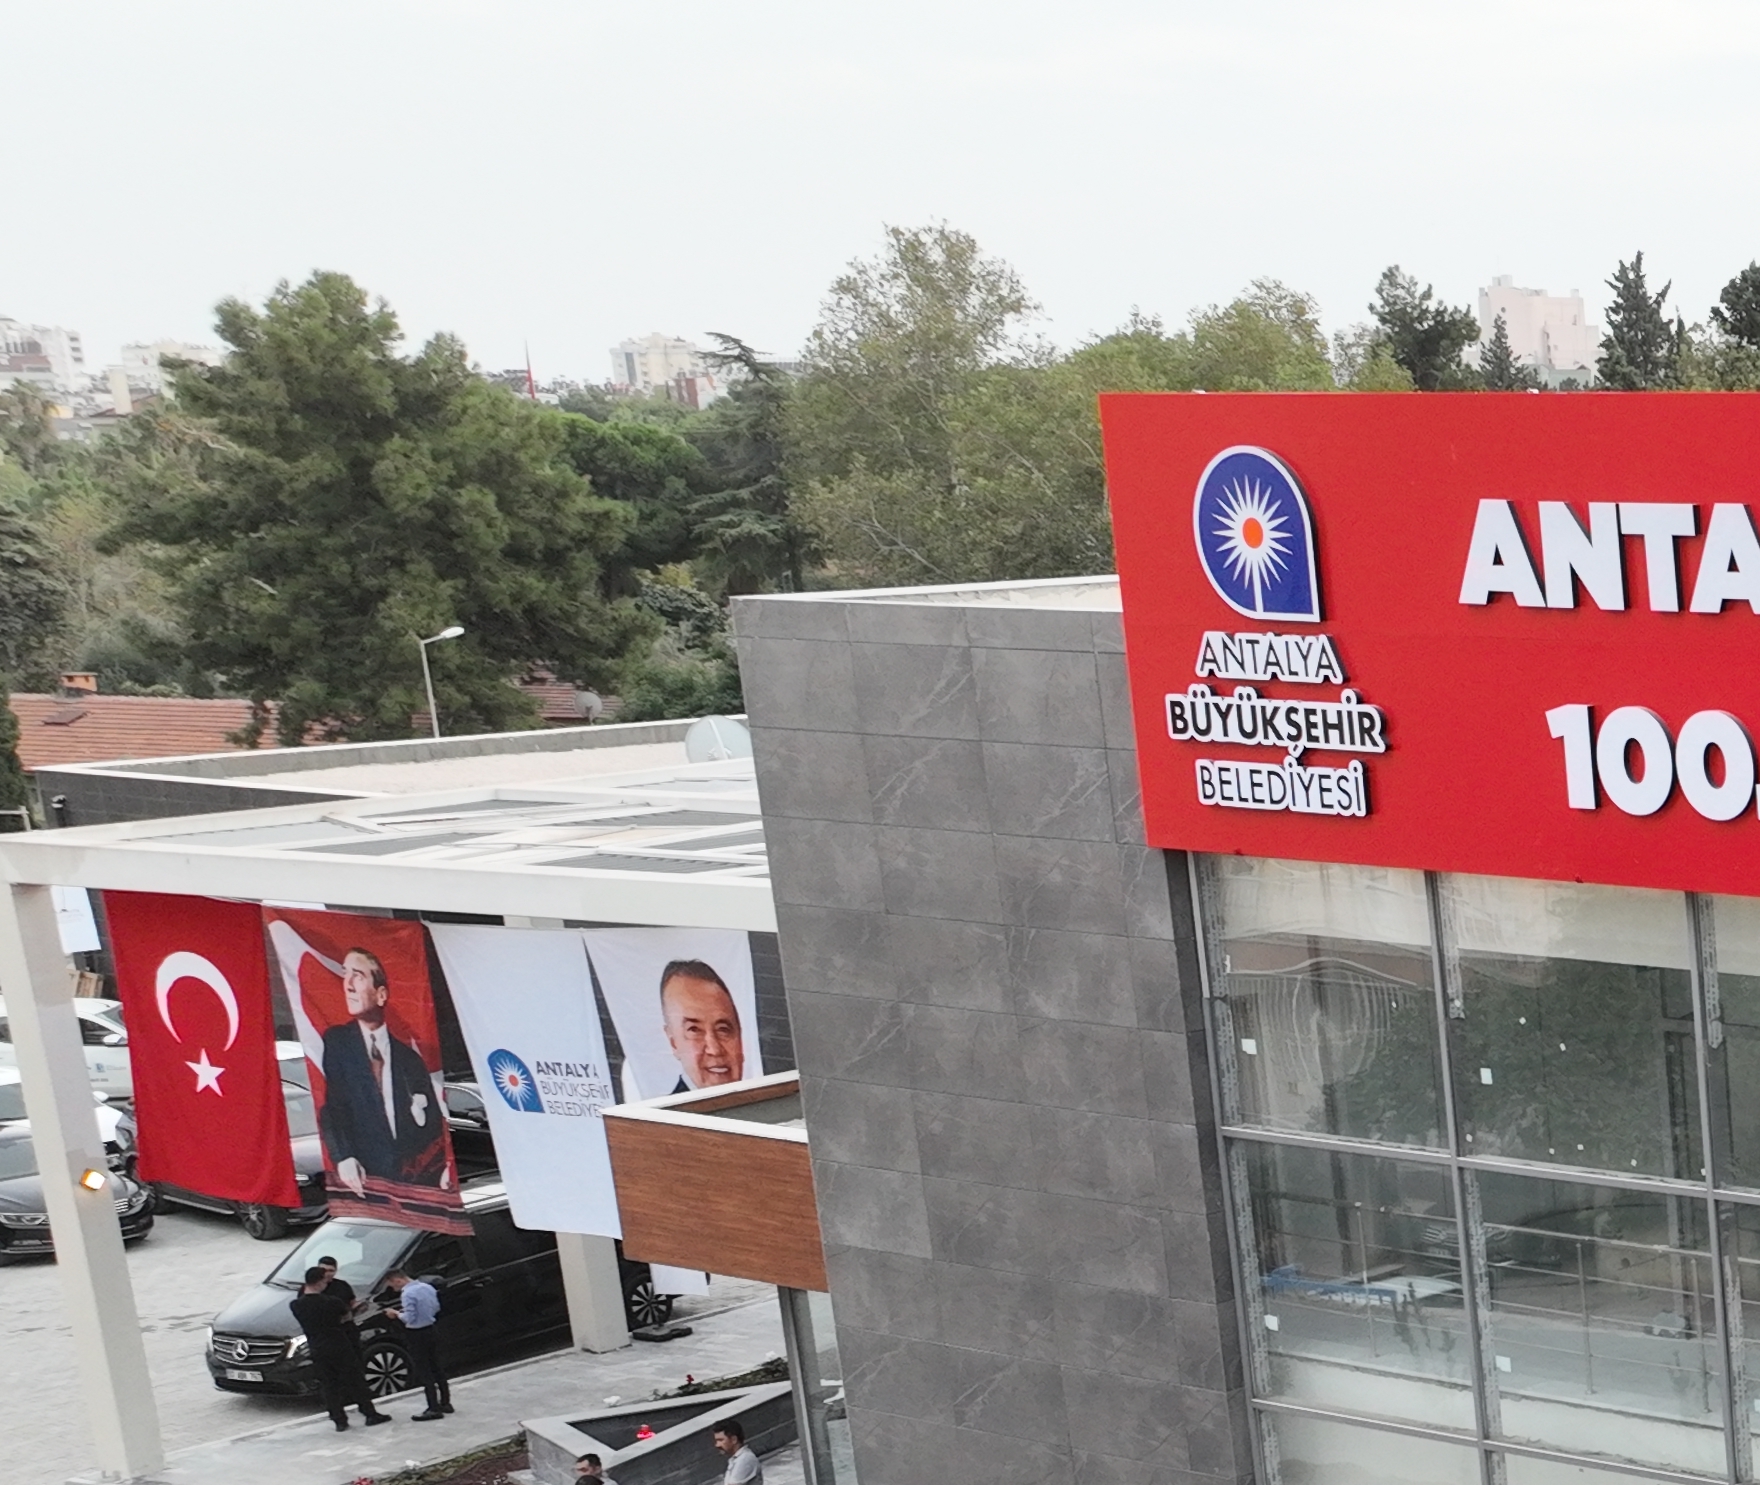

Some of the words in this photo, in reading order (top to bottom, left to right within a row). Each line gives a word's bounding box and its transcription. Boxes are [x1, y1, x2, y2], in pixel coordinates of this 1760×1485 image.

[1199, 635, 1339, 680] ANTALYA
[1169, 689, 1380, 752] BÜYÜKŞEHİR
[1199, 761, 1363, 811] BELEDİYESİ
[536, 1060, 600, 1080] ANTALYA
